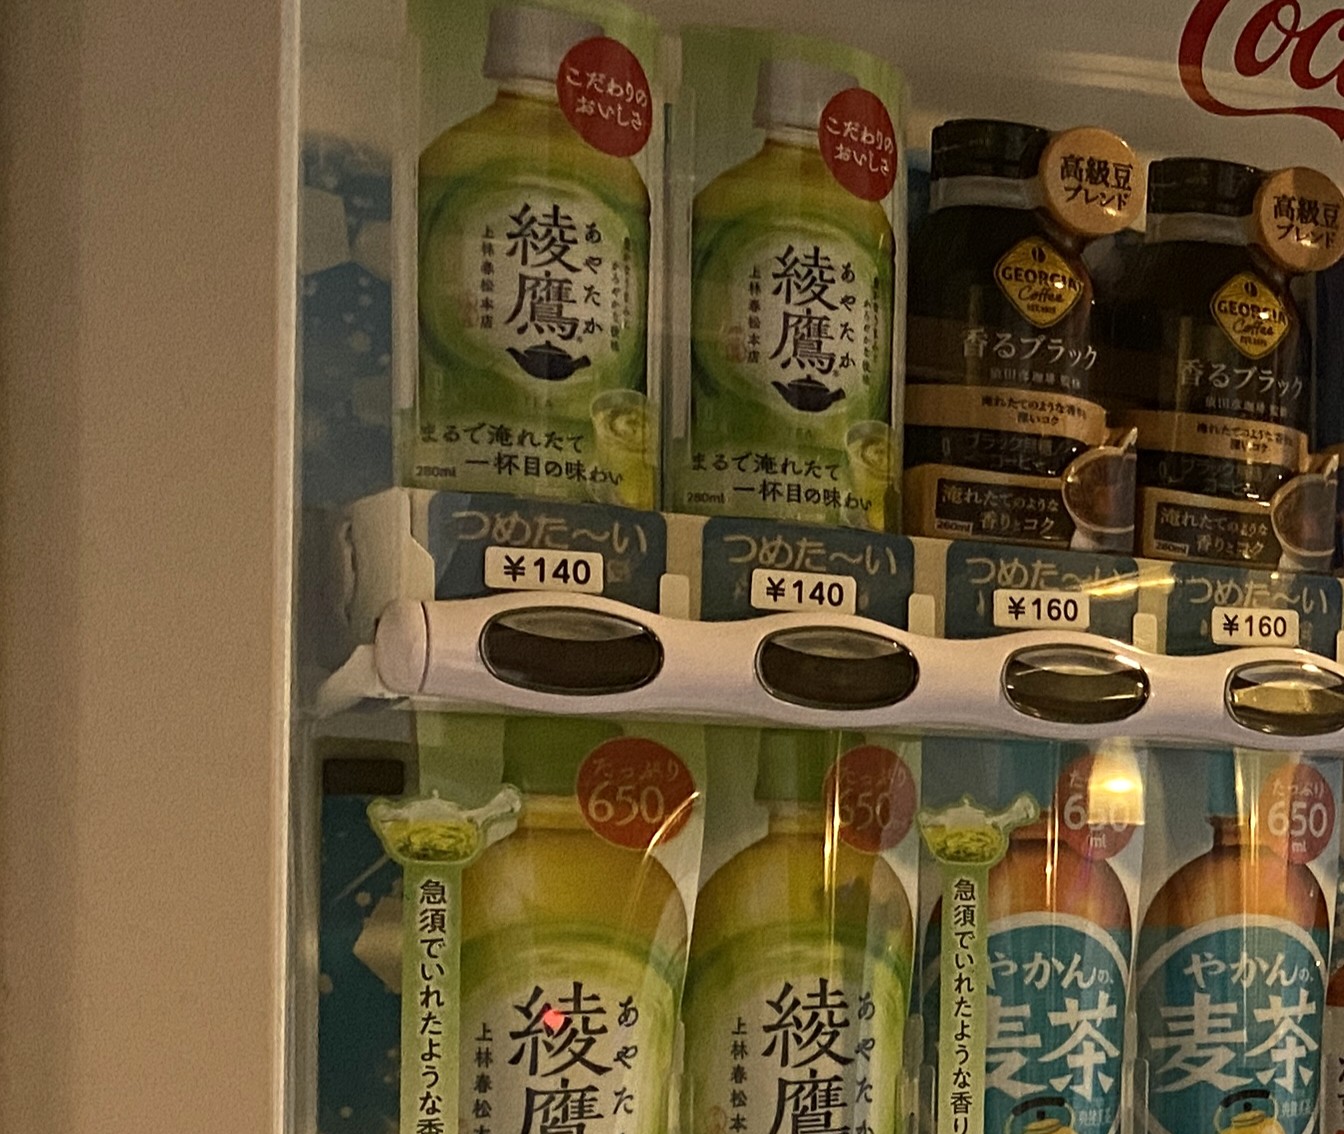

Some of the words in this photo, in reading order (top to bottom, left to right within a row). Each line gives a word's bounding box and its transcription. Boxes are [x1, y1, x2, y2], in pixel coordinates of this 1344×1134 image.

[566, 67, 649, 109] こだわりの
[576, 96, 643, 131] おいしさ
[826, 116, 894, 154] こだわりの
[1060, 153, 1134, 191] 高級豆
[1062, 185, 1131, 211] ブレンド
[1273, 194, 1340, 230] 高級豆
[504, 203, 581, 342] 綾鷹
[582, 222, 604, 336] あやたか
[770, 244, 841, 375] 綾鷹
[838, 264, 857, 369] あやたか
[962, 328, 1098, 371] 香るブラック
[1180, 360, 1303, 400] 香るブラック
[420, 423, 585, 454] まるで淹れたて
[465, 452, 625, 485] 一杯目の味わい
[503, 553, 592, 585] ¥140
[1008, 597, 1079, 622] ¥160
[1222, 614, 1288, 638] ¥160
[587, 783, 665, 826] 650
[1266, 801, 1328, 839] 650
[1291, 841, 1308, 854] ml
[1148, 990, 1320, 1096] 麦茶
